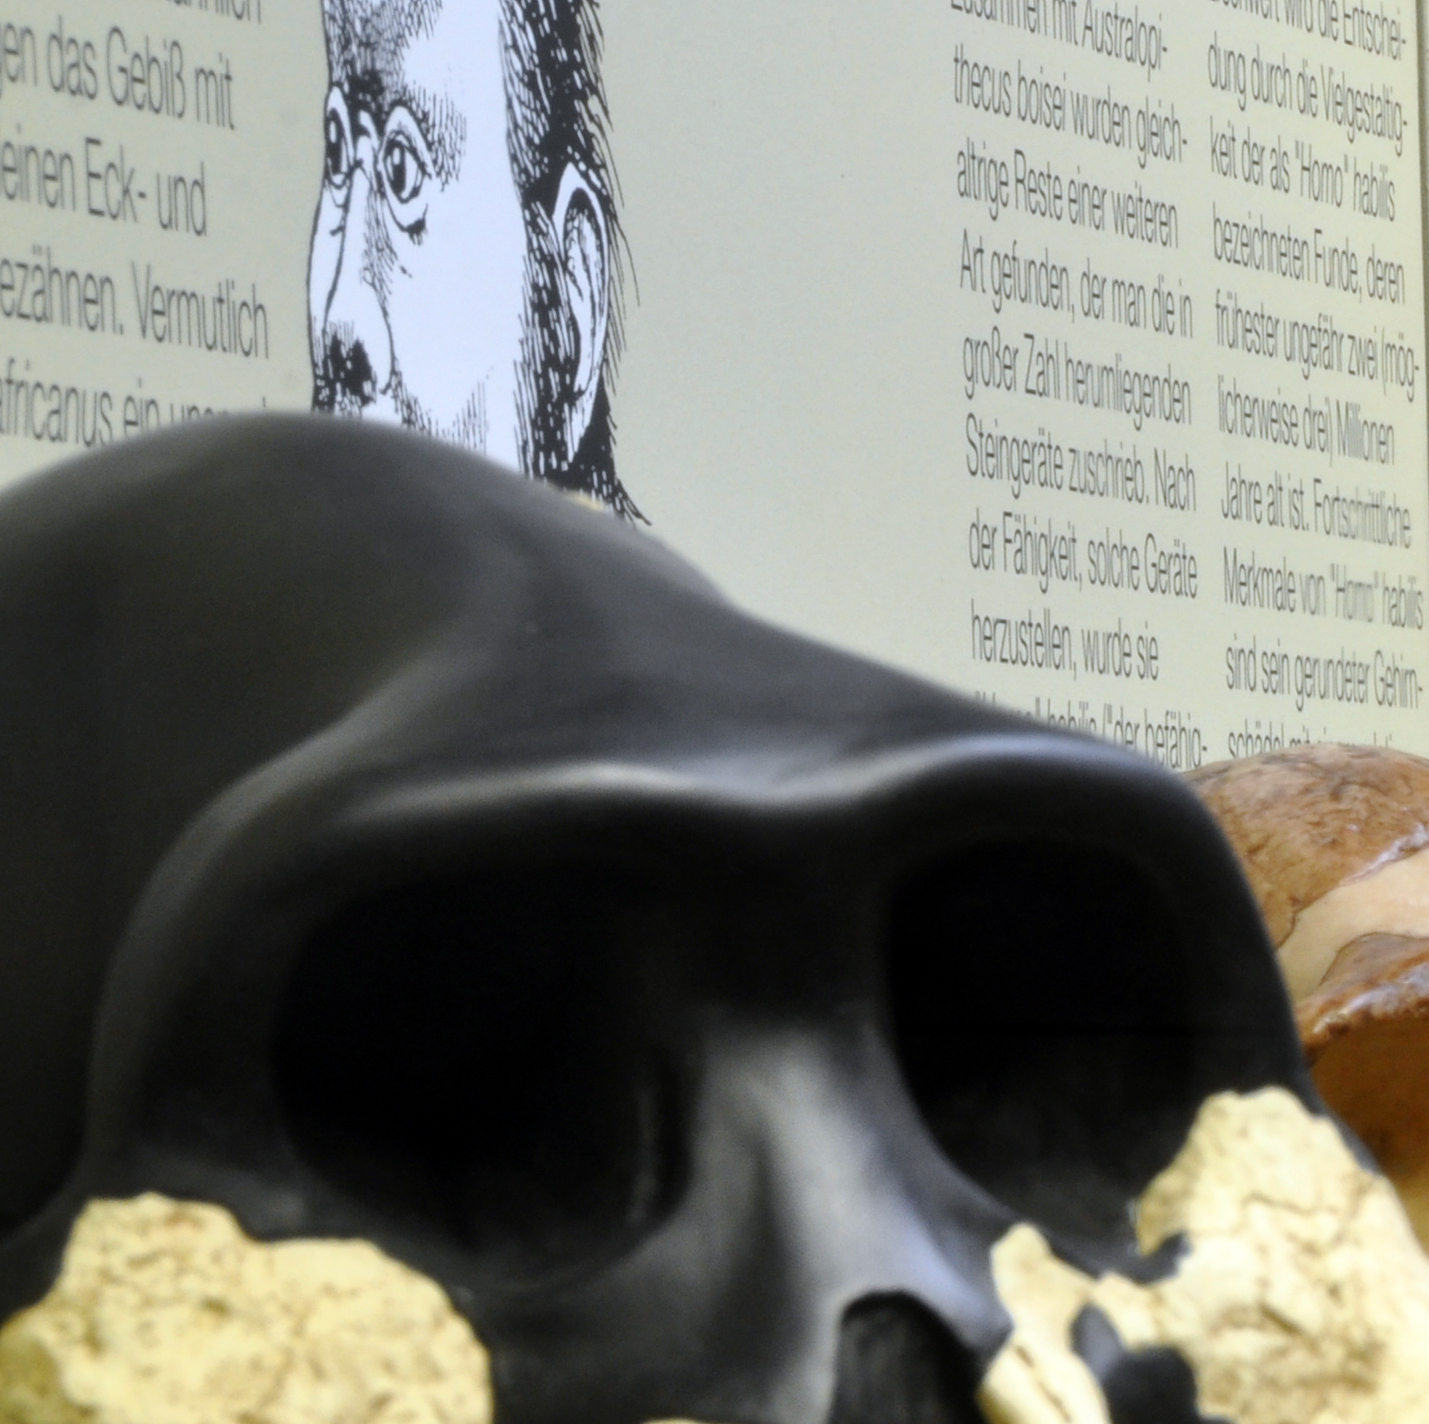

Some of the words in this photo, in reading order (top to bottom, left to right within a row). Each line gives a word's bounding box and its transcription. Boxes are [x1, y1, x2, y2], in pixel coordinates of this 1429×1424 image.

[46, 15, 98, 101] das
[106, 25, 186, 119] Gebiß
[195, 53, 235, 131] mit
[1053, 0, 1078, 45] mit
[1082, 0, 1168, 81] Australopi-
[1344, 0, 1406, 60] Entschei-
[954, 43, 1011, 117] thecus
[1018, 59, 1065, 131] boisei
[1070, 85, 1131, 149] wurden
[1136, 96, 1187, 169] gleich-
[1208, 30, 1247, 111] dung
[1251, 44, 1292, 110] durch
[1296, 58, 1318, 117] die
[1320, 64, 1408, 157] Vielgestaltig-
[85, 137, 147, 223] Eck-
[156, 161, 207, 236] und
[957, 136, 1009, 221] altrige
[1014, 148, 1062, 221] Reste
[1068, 165, 1107, 231] einer
[1111, 181, 1178, 248] weiteren
[1210, 115, 1237, 178] keit
[1242, 125, 1265, 185] der
[1269, 134, 1290, 193] als
[1295, 139, 1348, 207] "Homo"
[1353, 156, 1395, 221] habilis
[960, 229, 986, 293] Art
[990, 240, 1075, 323] gefunden,
[1081, 257, 1107, 319] der
[1112, 279, 1146, 329] man
[1152, 273, 1175, 335] die
[1179, 278, 1192, 338] in
[1212, 201, 1310, 281] bezeichneten
[1314, 228, 1362, 303] Funde,
[1366, 243, 1405, 304] deren
[131, 260, 269, 359] Vermutlich
[1215, 288, 1280, 357] frühester
[1283, 312, 1344, 380] ungefähr
[1347, 325, 1378, 380] zwei
[0, 356, 113, 447] fricanus
[963, 326, 1019, 399] großer
[1024, 333, 1061, 400] Zahl
[1064, 342, 1191, 431] herumliegenden
[1217, 374, 1299, 447] licherweise
[1303, 394, 1333, 468] drei)
[1336, 399, 1395, 465] Millionen
[966, 412, 1063, 499] Steingeräte
[1068, 438, 1149, 504] zuschrieb.
[1154, 447, 1196, 512] Nach
[1221, 461, 1263, 525] Jahre
[1267, 470, 1284, 528] alt
[1287, 473, 1309, 531] ist.
[969, 507, 997, 570] der
[1003, 511, 1082, 594] Fähigkeit,
[1088, 527, 1140, 590] solche
[1144, 533, 1197, 598] Geräte
[1223, 546, 1295, 613] Merkmale
[1300, 573, 1326, 617] von
[971, 599, 1077, 681] herzustellen,
[1081, 617, 1132, 677] wurde
[1137, 621, 1158, 680] sie
[1226, 633, 1256, 692] sind
[1261, 638, 1290, 696] sein
[1294, 646, 1370, 712] gerundeter
[1373, 649, 1423, 709] Gehirn-
